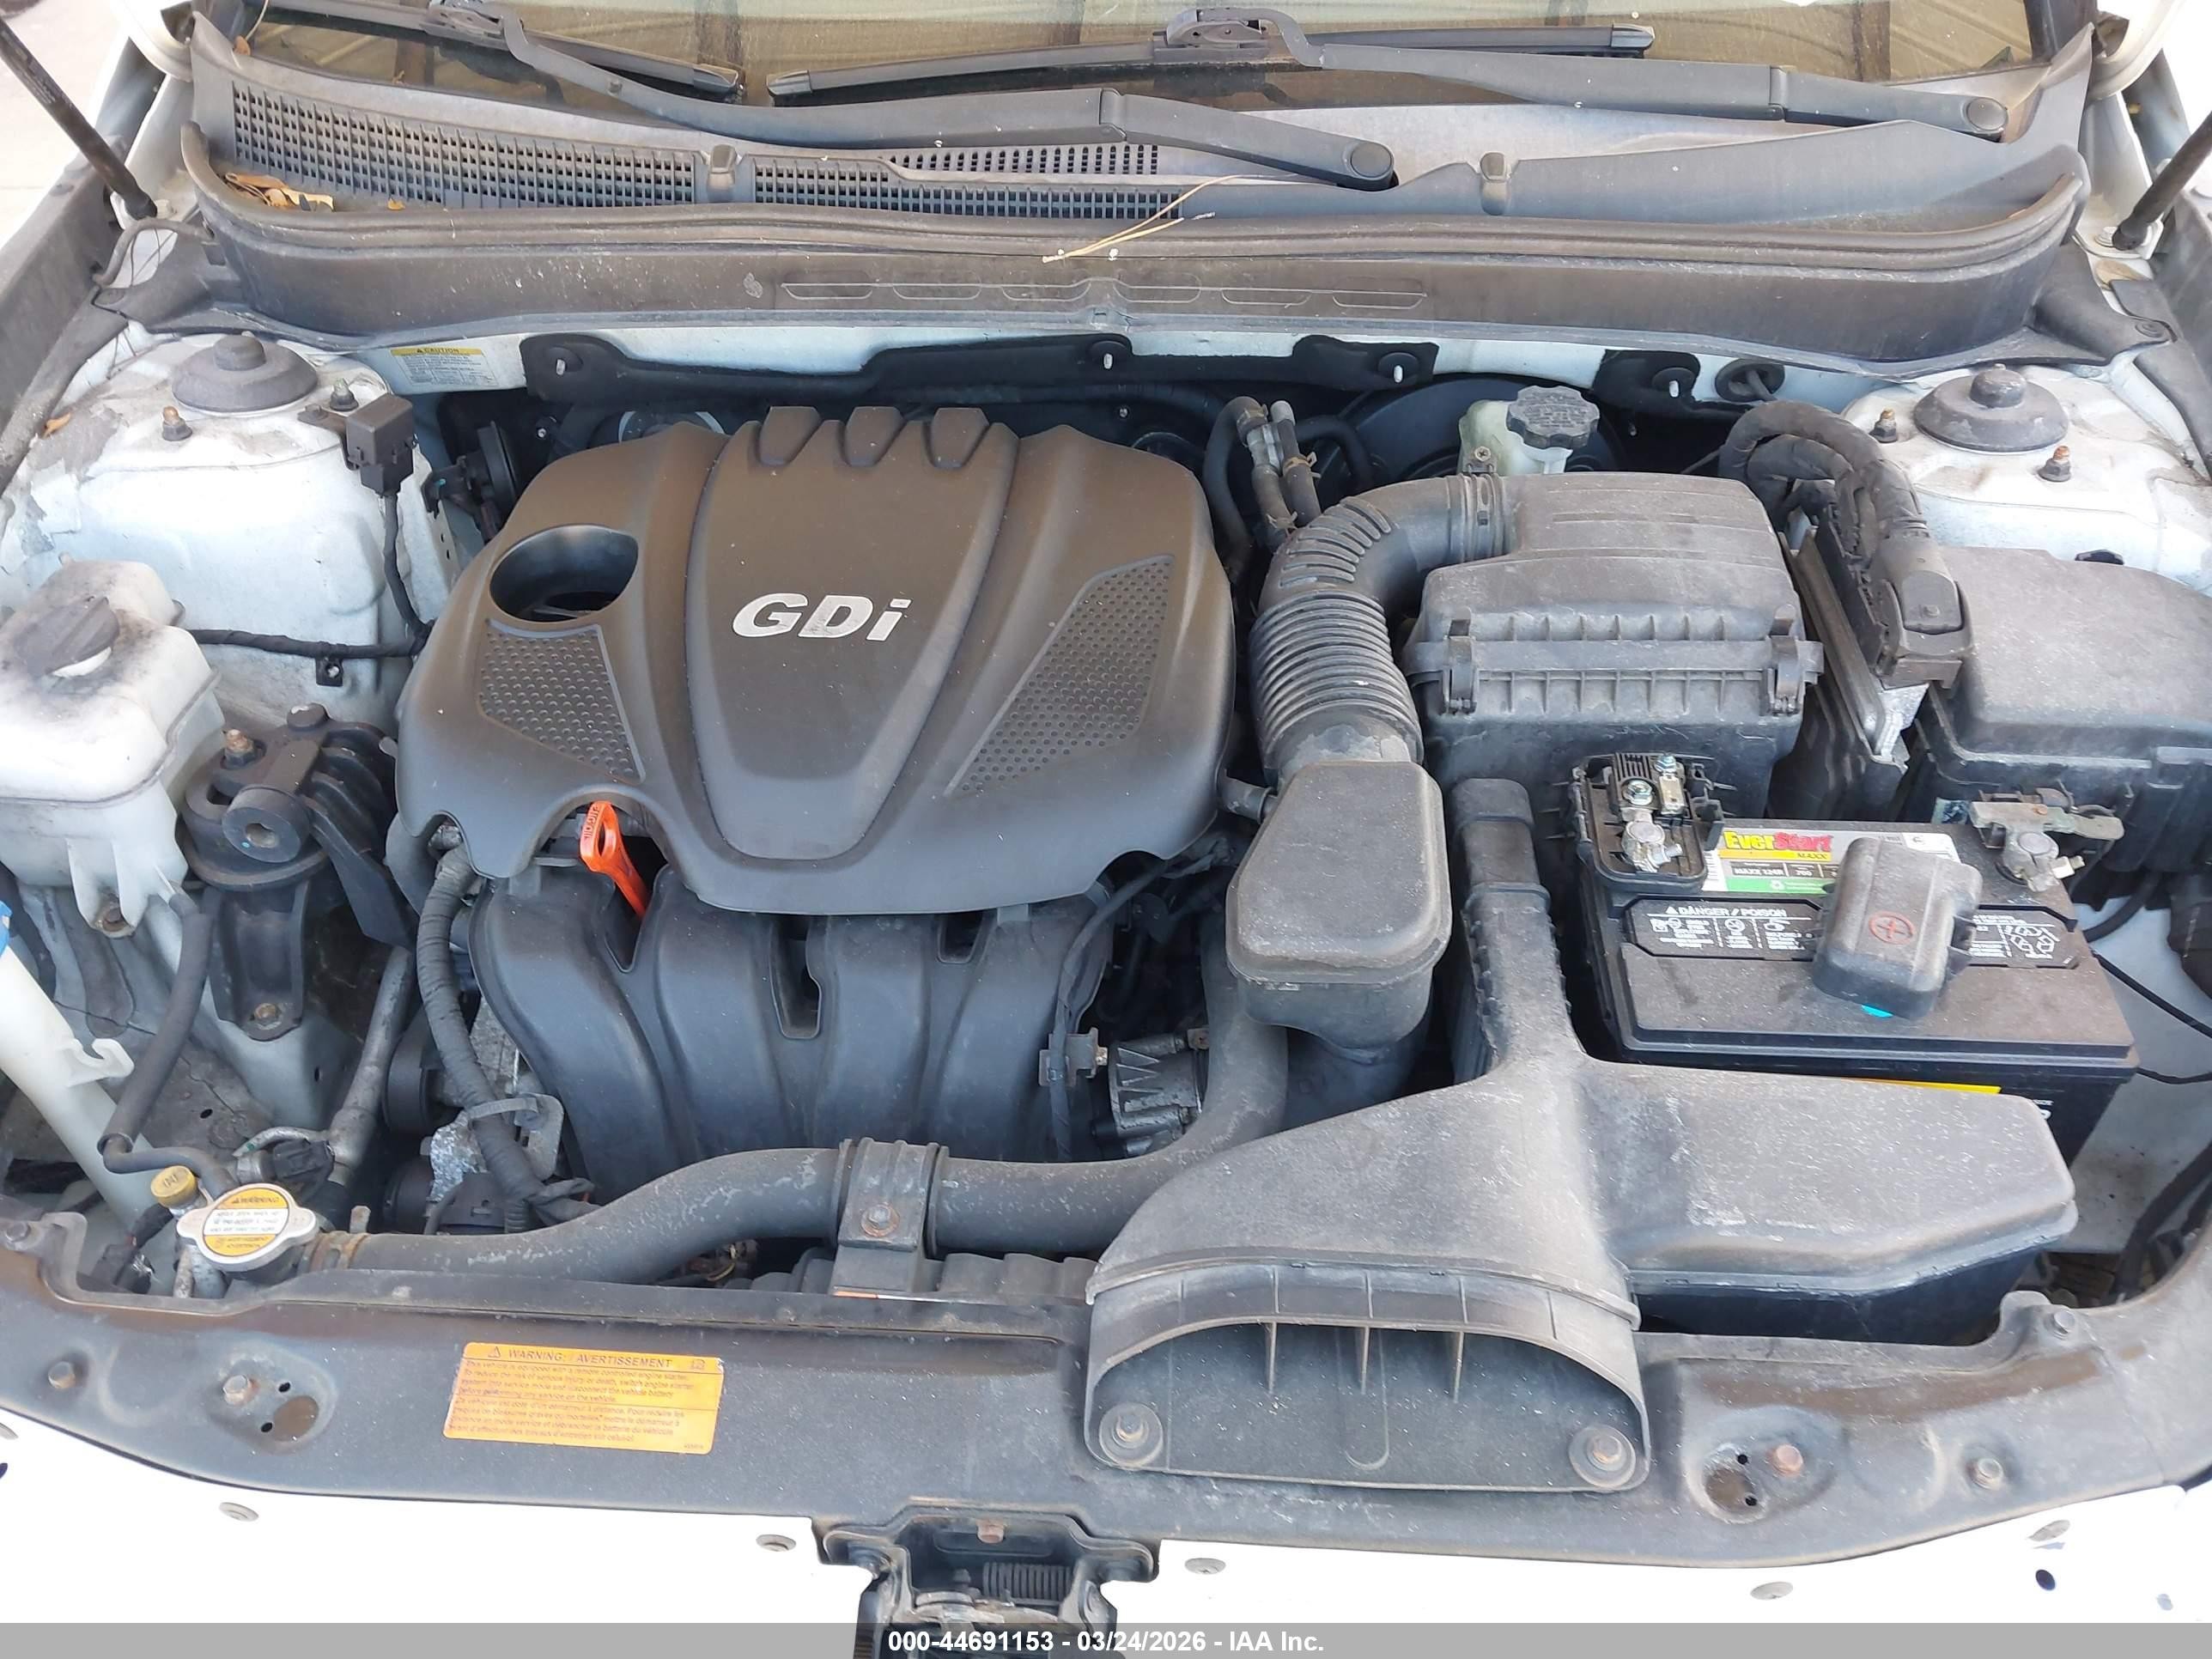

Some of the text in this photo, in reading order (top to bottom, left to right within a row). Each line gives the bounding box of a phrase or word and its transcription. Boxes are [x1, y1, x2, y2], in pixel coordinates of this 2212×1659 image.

[732, 592, 912, 641] GDi
[1723, 830, 1833, 853] EverStart
[1677, 907, 1729, 916] DANGER
[1741, 908, 1788, 917] POISON
[576, 1353, 673, 1368] AVERTISSEMENT
